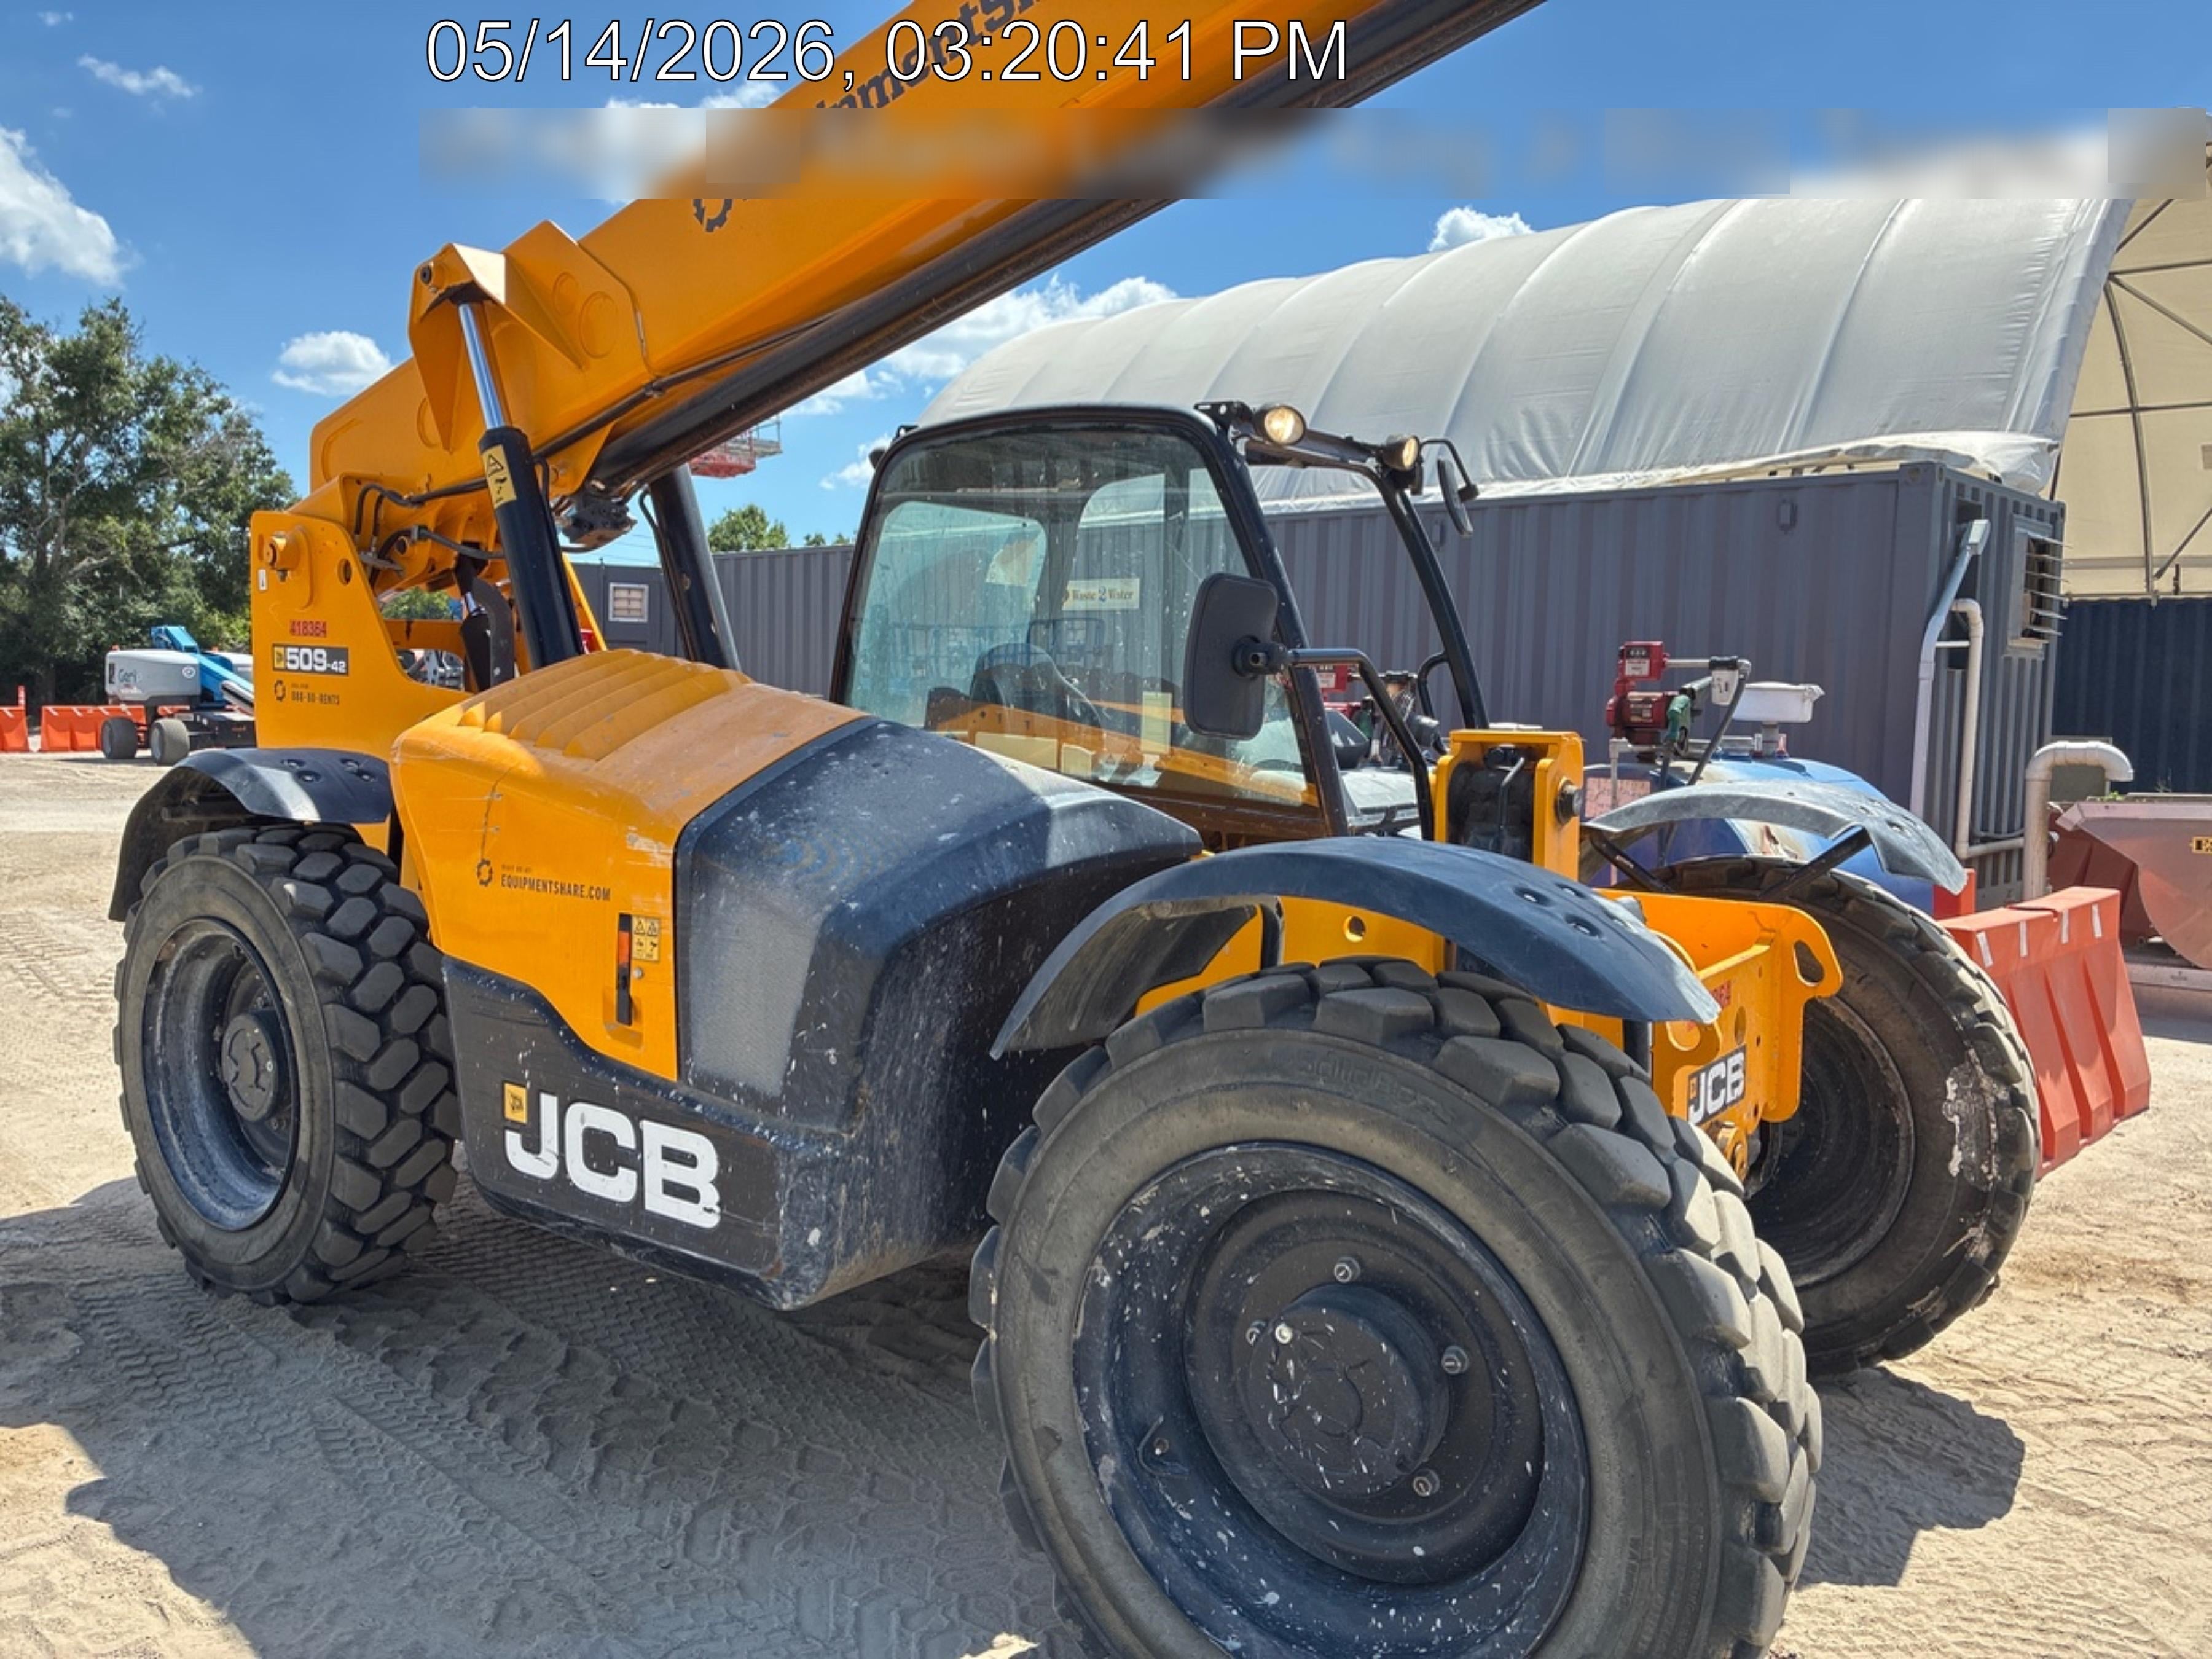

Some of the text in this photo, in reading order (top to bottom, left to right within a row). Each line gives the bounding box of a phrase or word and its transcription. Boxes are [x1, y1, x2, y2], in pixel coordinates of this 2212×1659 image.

[501, 873, 611, 901] EQUIPMENTSHARE.COM
[1688, 1051, 1744, 1126] JCB
[504, 1092, 720, 1228] JCB
